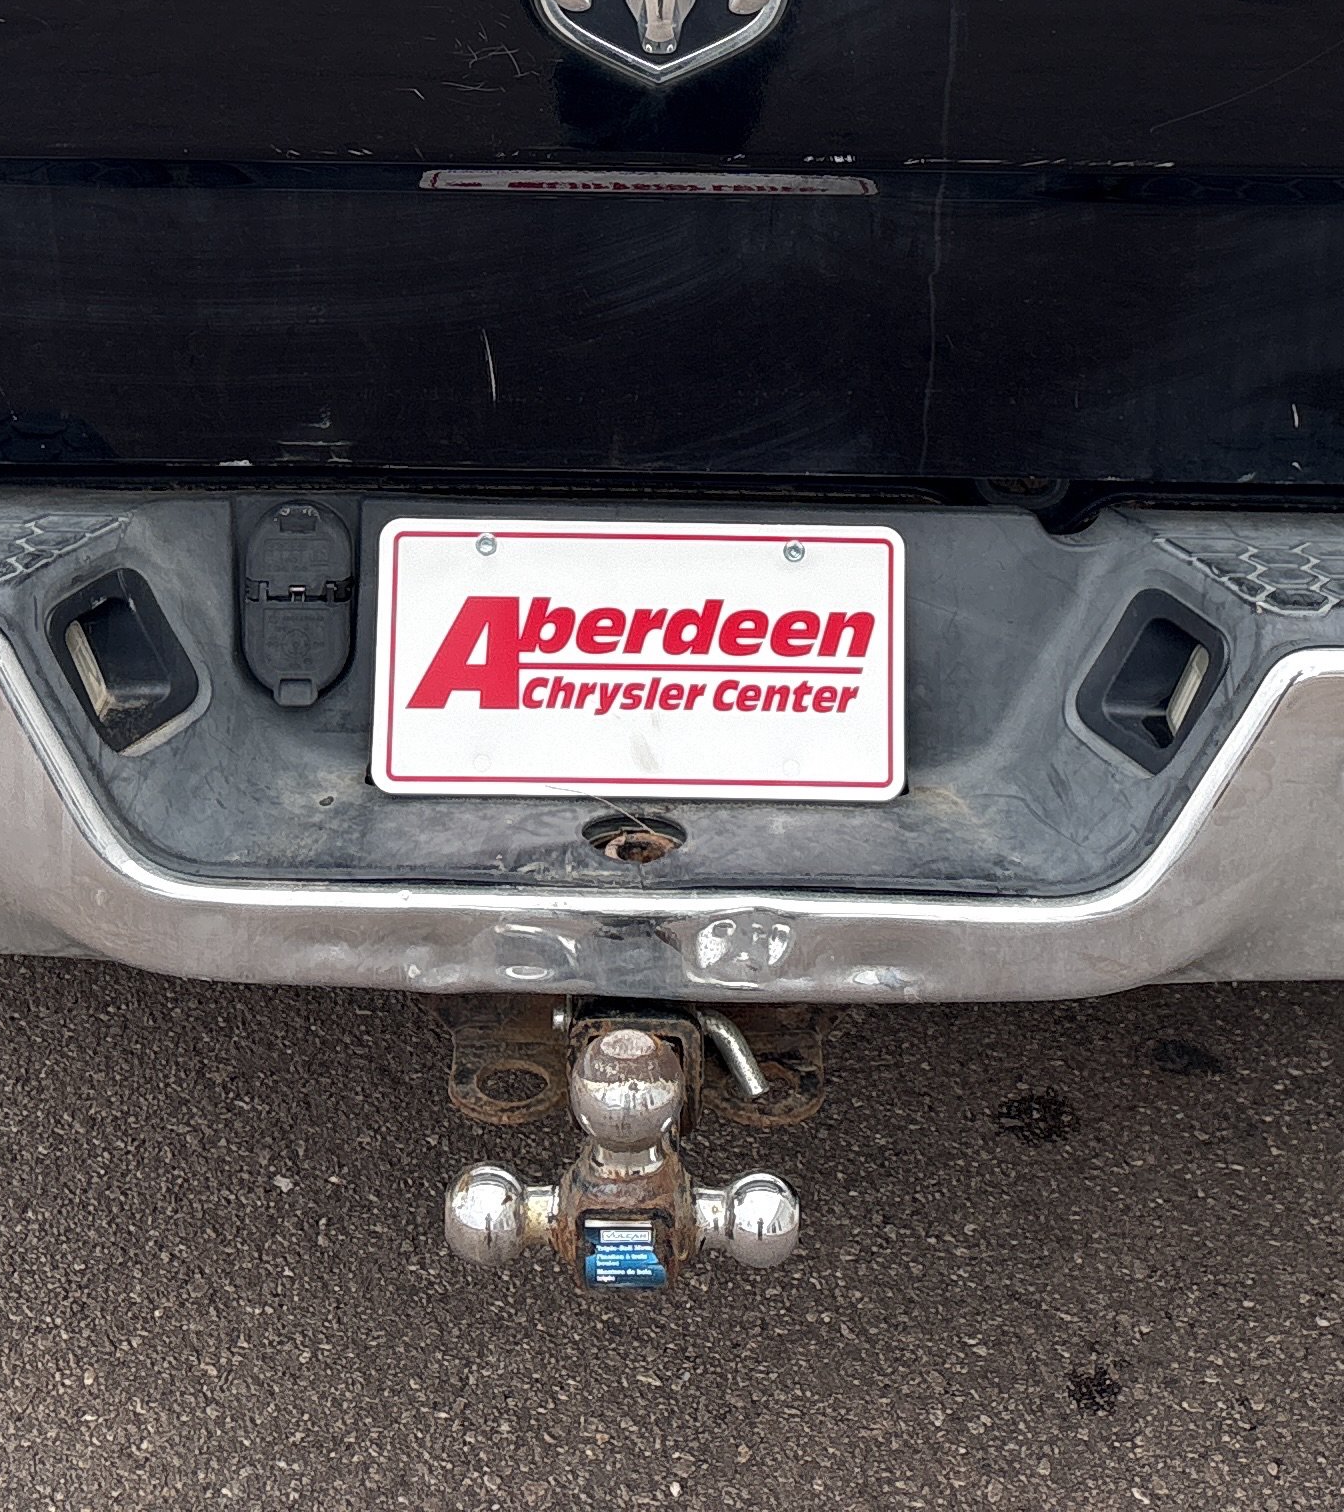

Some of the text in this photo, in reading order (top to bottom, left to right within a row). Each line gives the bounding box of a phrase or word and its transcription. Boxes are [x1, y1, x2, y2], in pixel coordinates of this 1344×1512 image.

[406, 595, 876, 710] Aberdeen
[520, 675, 860, 716] Chrysler Center
